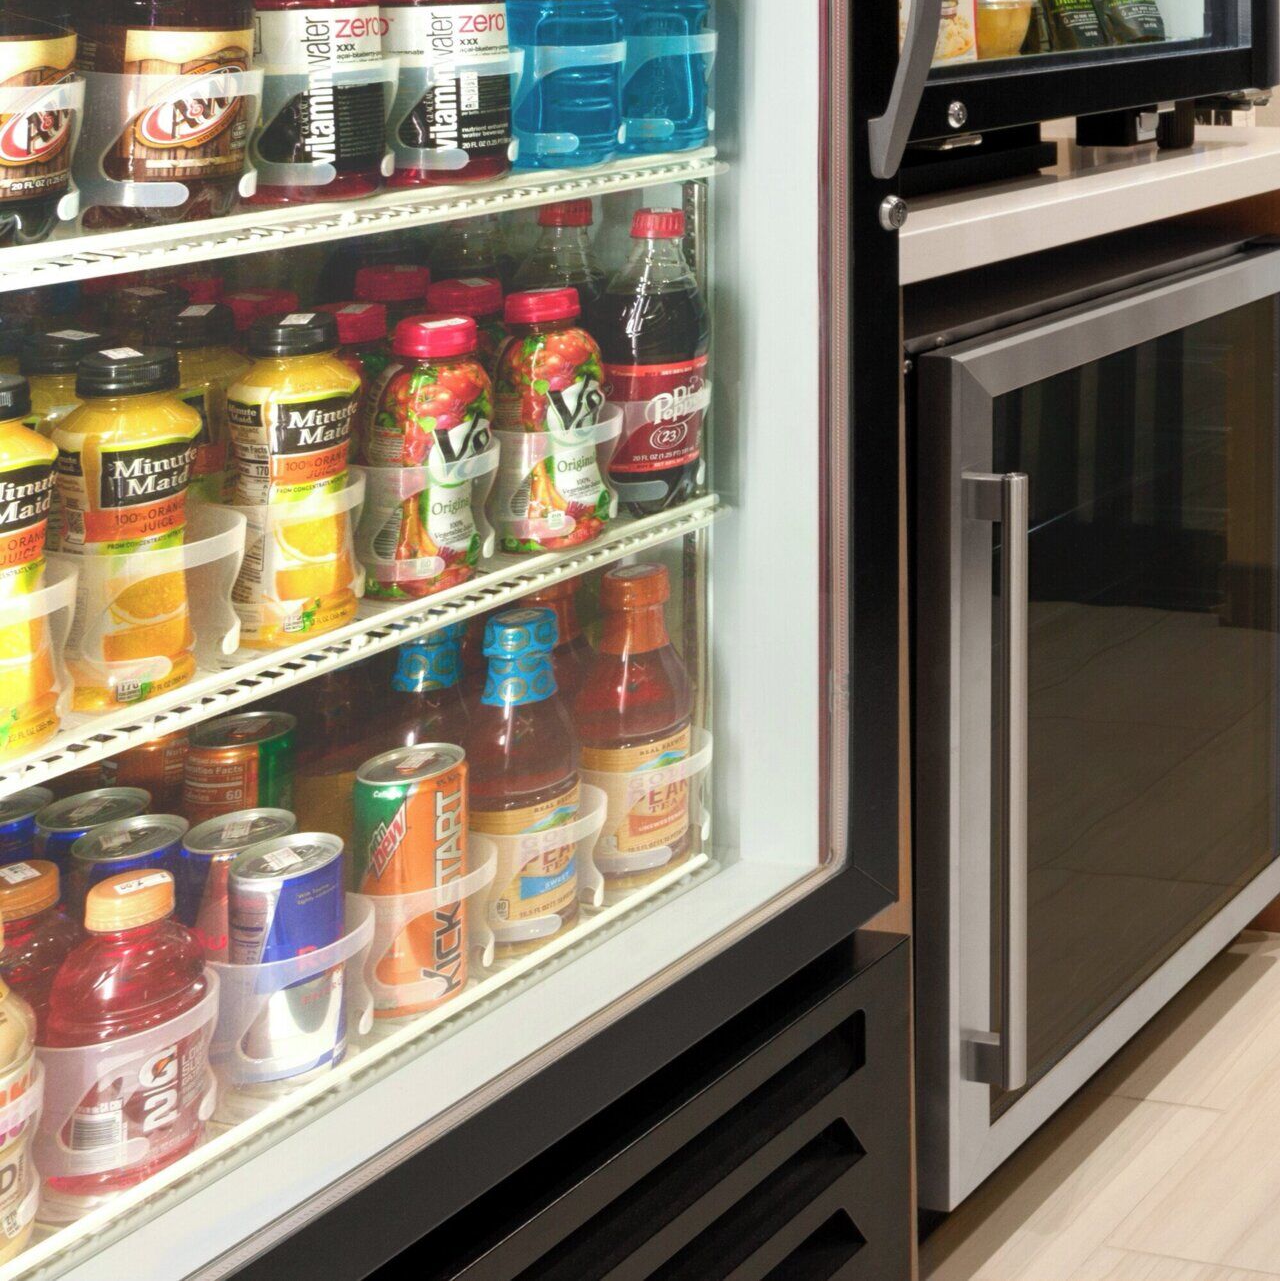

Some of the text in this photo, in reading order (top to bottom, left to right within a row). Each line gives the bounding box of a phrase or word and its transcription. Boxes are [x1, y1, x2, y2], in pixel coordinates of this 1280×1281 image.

[336, 16, 388, 39] zero
[458, 14, 505, 34] zero
[301, 15, 337, 167] vitaminwater
[427, 12, 459, 151] vitaminwater
[10, 179, 46, 191] 20 FL OZ
[289, 401, 358, 429] Minute
[547, 374, 606, 431] V8
[300, 423, 349, 447] Maid
[434, 412, 490, 463] V8
[661, 428, 678, 444] 23
[113, 447, 199, 479] Minute
[632, 452, 658, 463] 20 FL OZ
[128, 471, 190, 498] Maid
[140, 516, 175, 535] JUICE
[648, 796, 679, 814] TEA
[370, 801, 408, 879] DEW
[421, 790, 465, 1000] KICKSTART
[142, 1093, 181, 1133] 2
